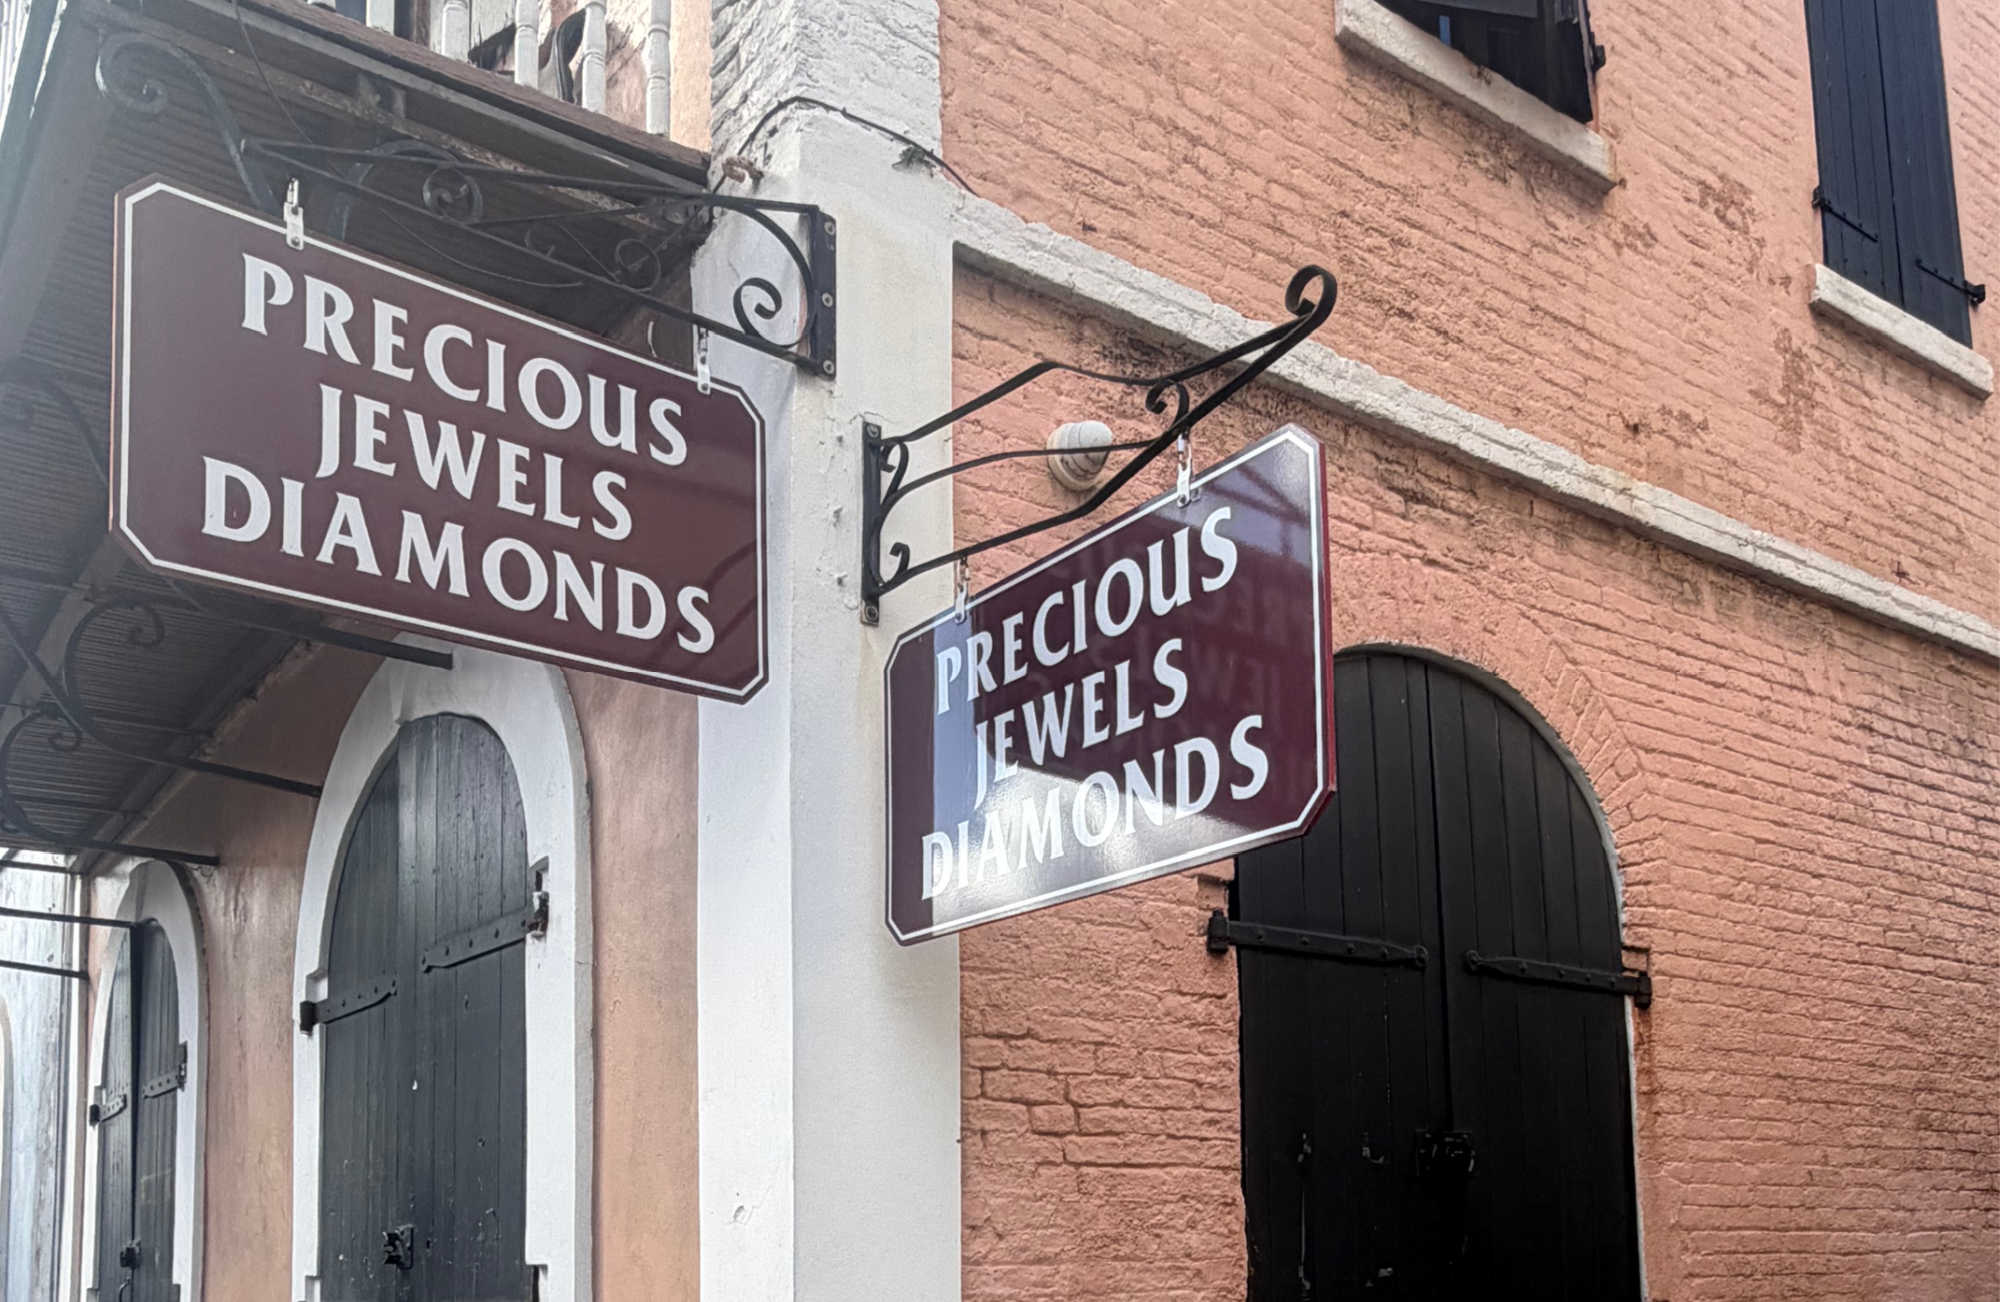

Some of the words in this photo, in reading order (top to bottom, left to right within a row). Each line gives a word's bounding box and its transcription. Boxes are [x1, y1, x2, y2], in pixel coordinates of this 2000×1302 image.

[241, 252, 688, 466] PRECIOUS
[201, 456, 716, 654] DIAMONDS
[316, 384, 632, 541] JEWELS
[936, 507, 1238, 715] PRECIOUS
[921, 714, 1269, 899] DIAMONDS
[975, 638, 1188, 810] JEWELS
